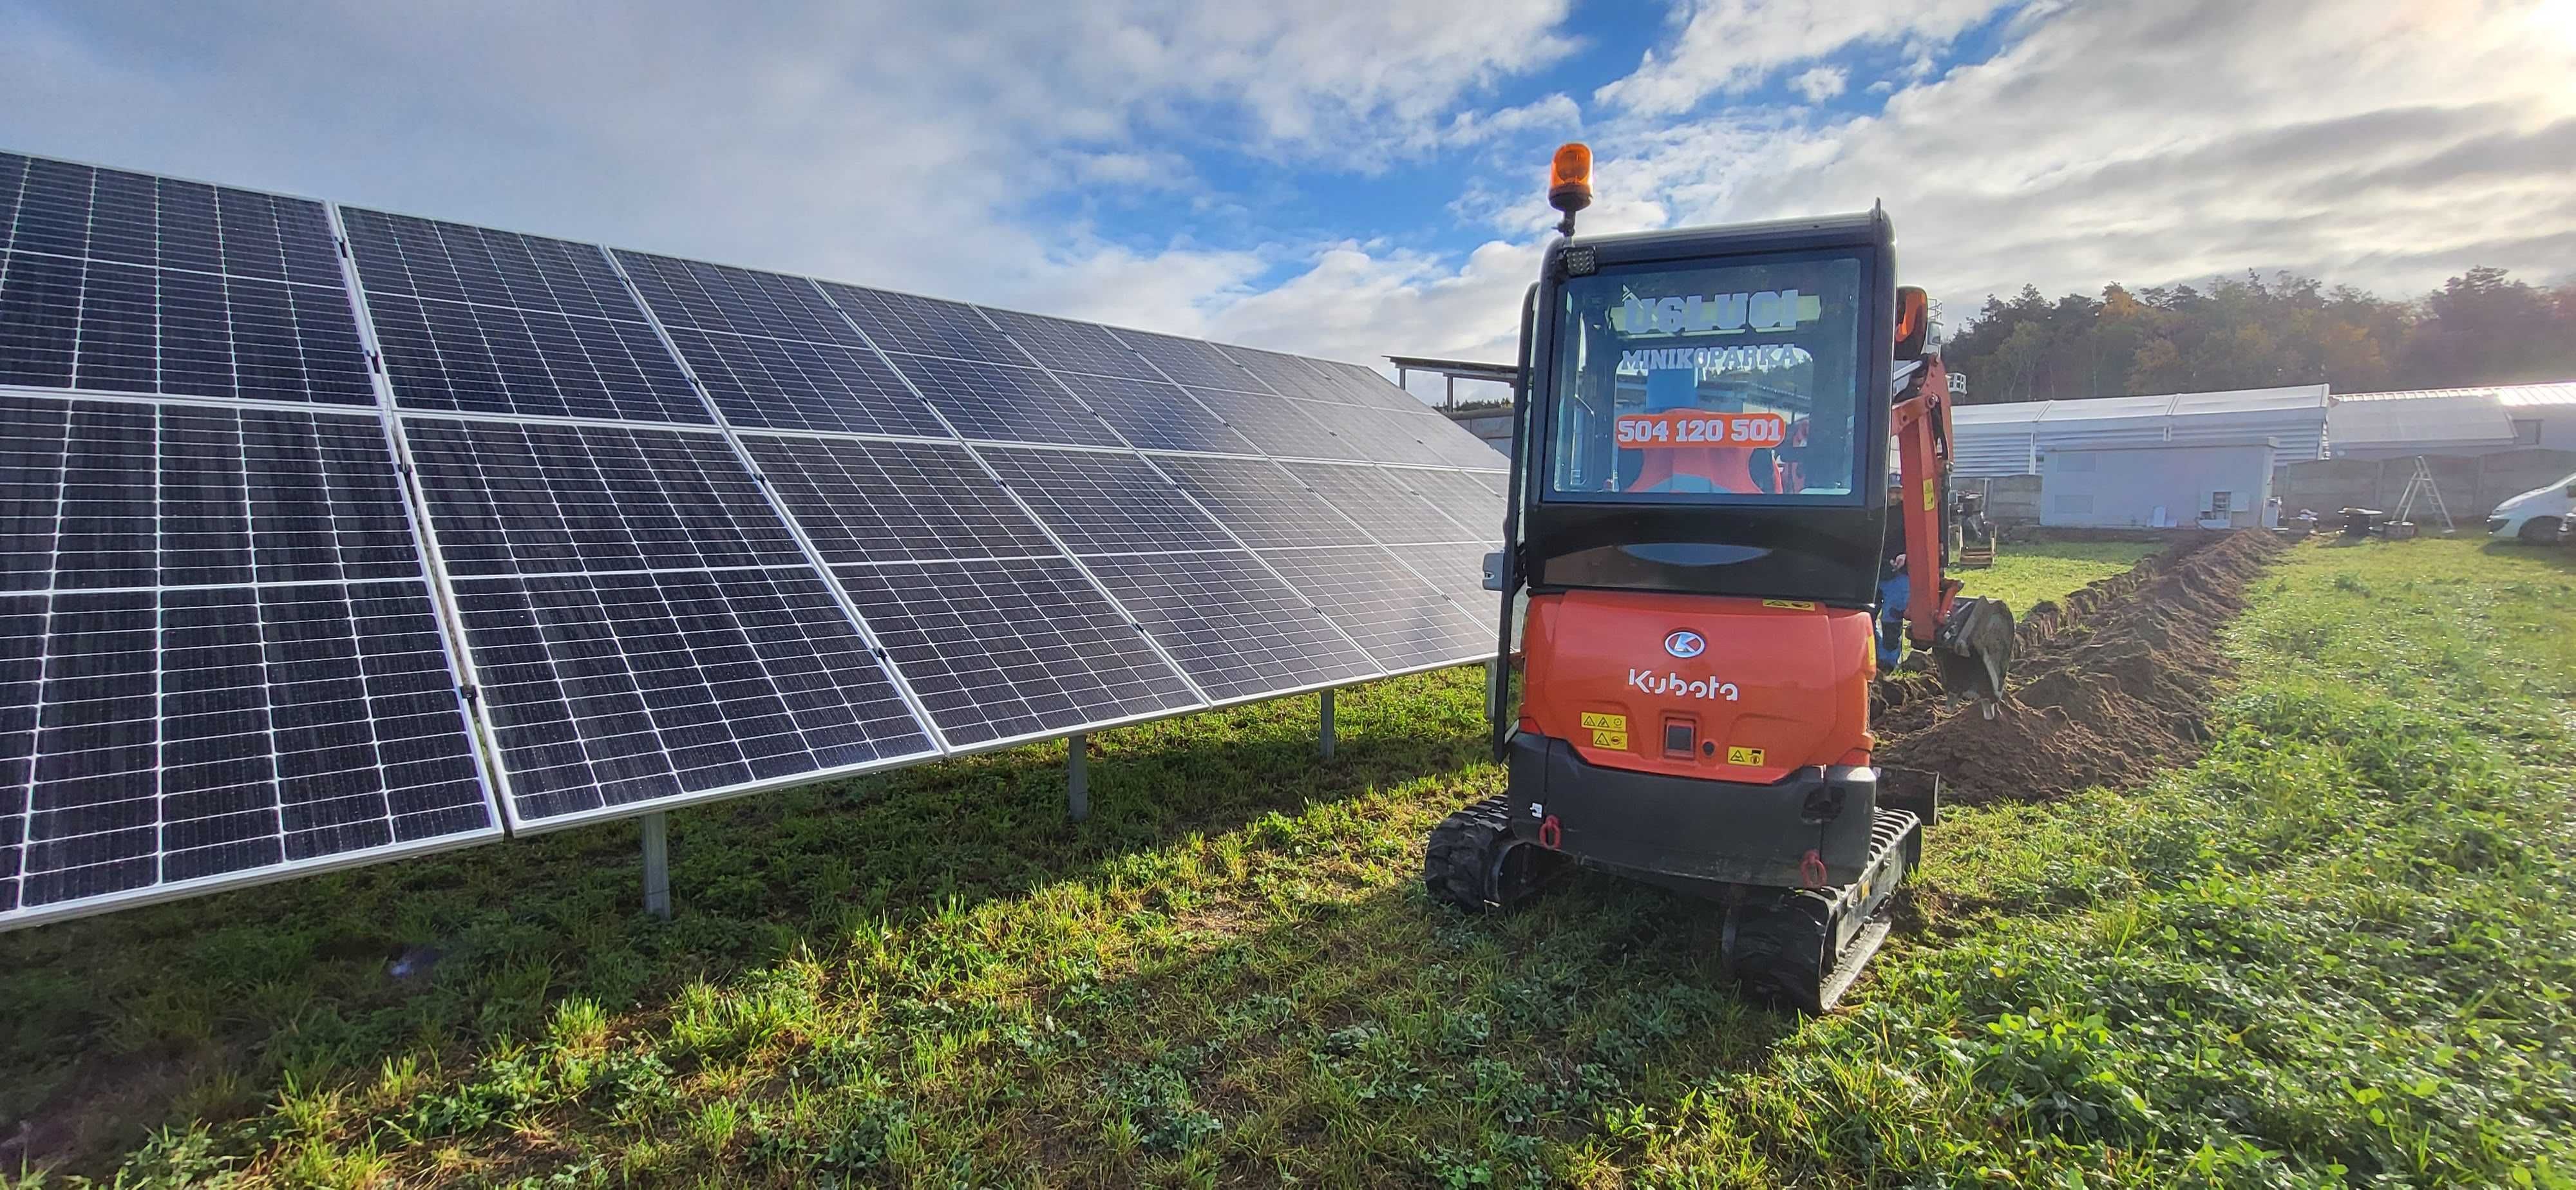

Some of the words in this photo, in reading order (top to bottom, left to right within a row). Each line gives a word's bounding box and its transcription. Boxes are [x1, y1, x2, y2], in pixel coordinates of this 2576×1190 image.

[1622, 344, 1797, 370] MINIKOPARKA
[1618, 420, 1669, 442] 504
[1676, 420, 1723, 442] 120
[1730, 419, 1781, 441] 501
[1628, 668, 1738, 701] Kubota
